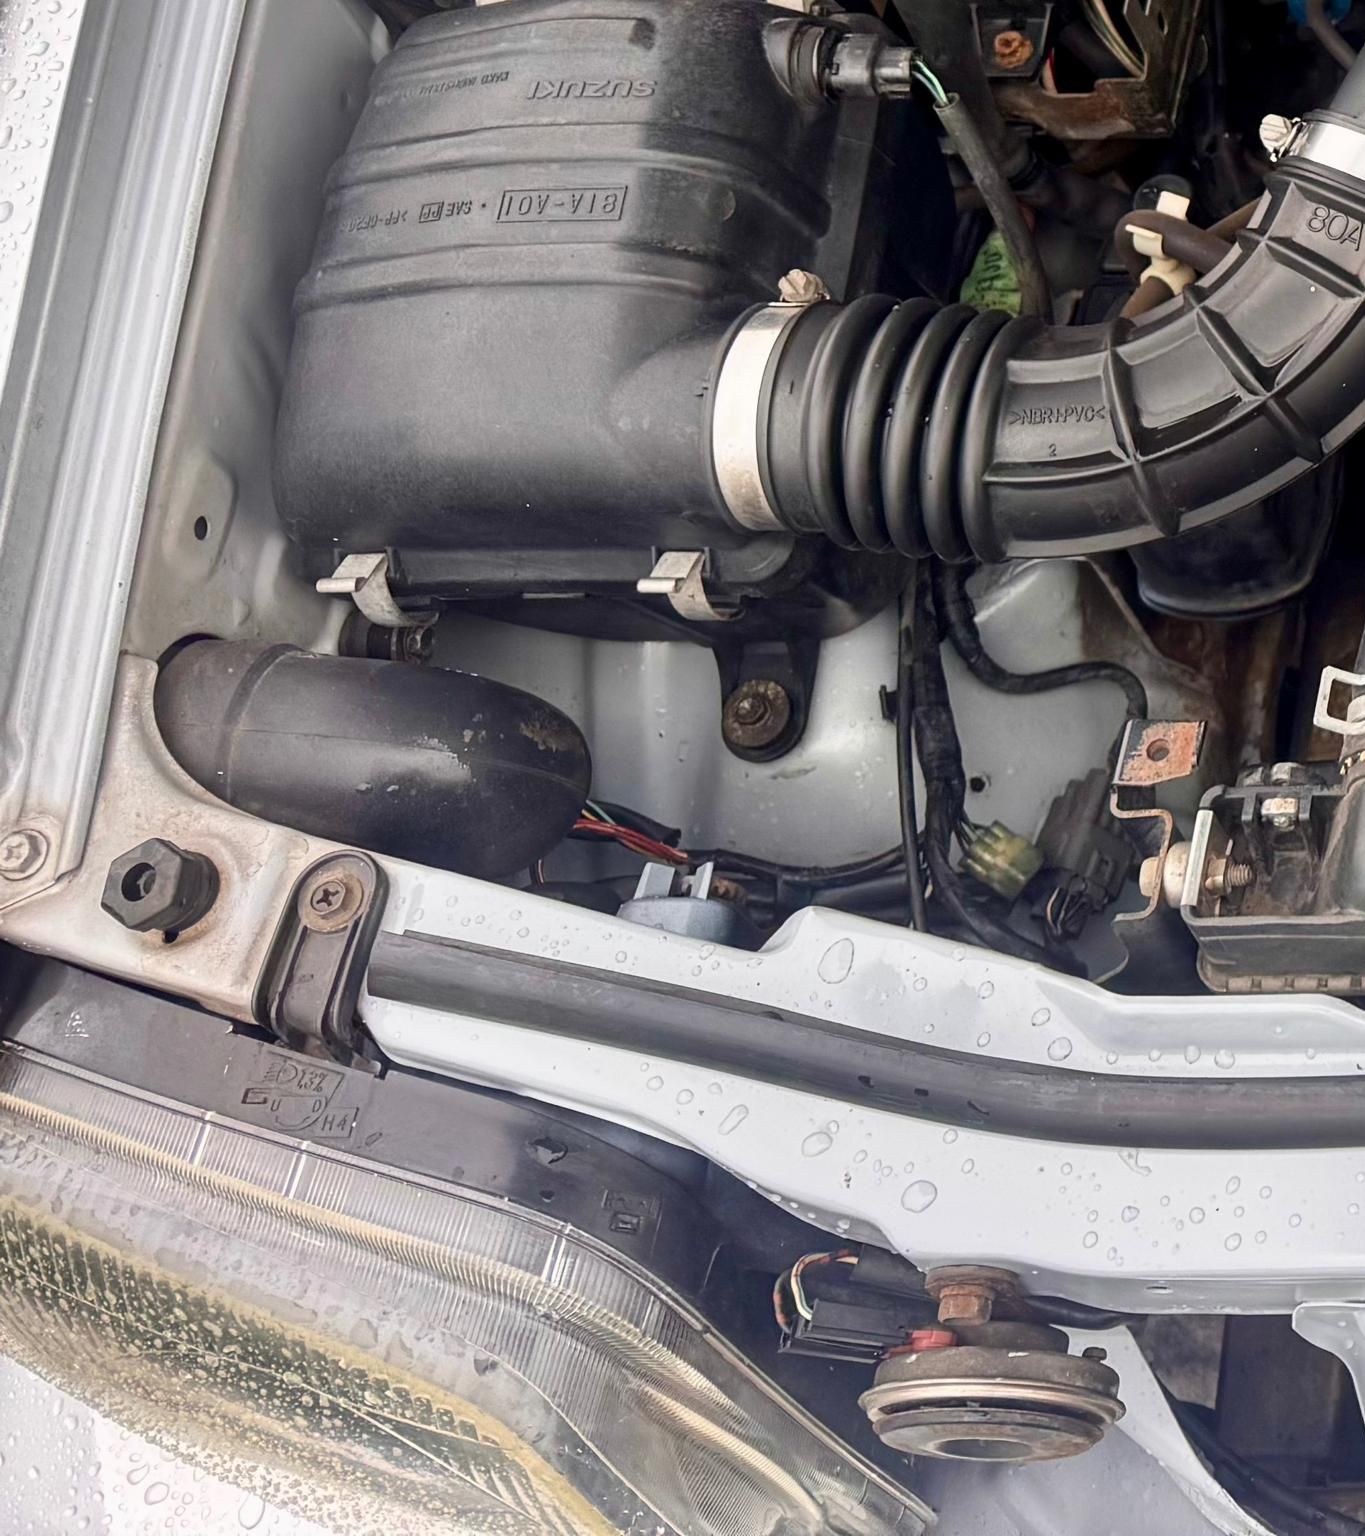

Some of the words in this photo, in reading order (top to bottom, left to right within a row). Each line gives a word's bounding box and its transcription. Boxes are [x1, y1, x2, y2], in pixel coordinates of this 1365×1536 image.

[526, 78, 659, 101] SUZUKI
[446, 199, 473, 217] SAE
[1305, 205, 1365, 252] 80A
[321, 1114, 348, 1132] H4
